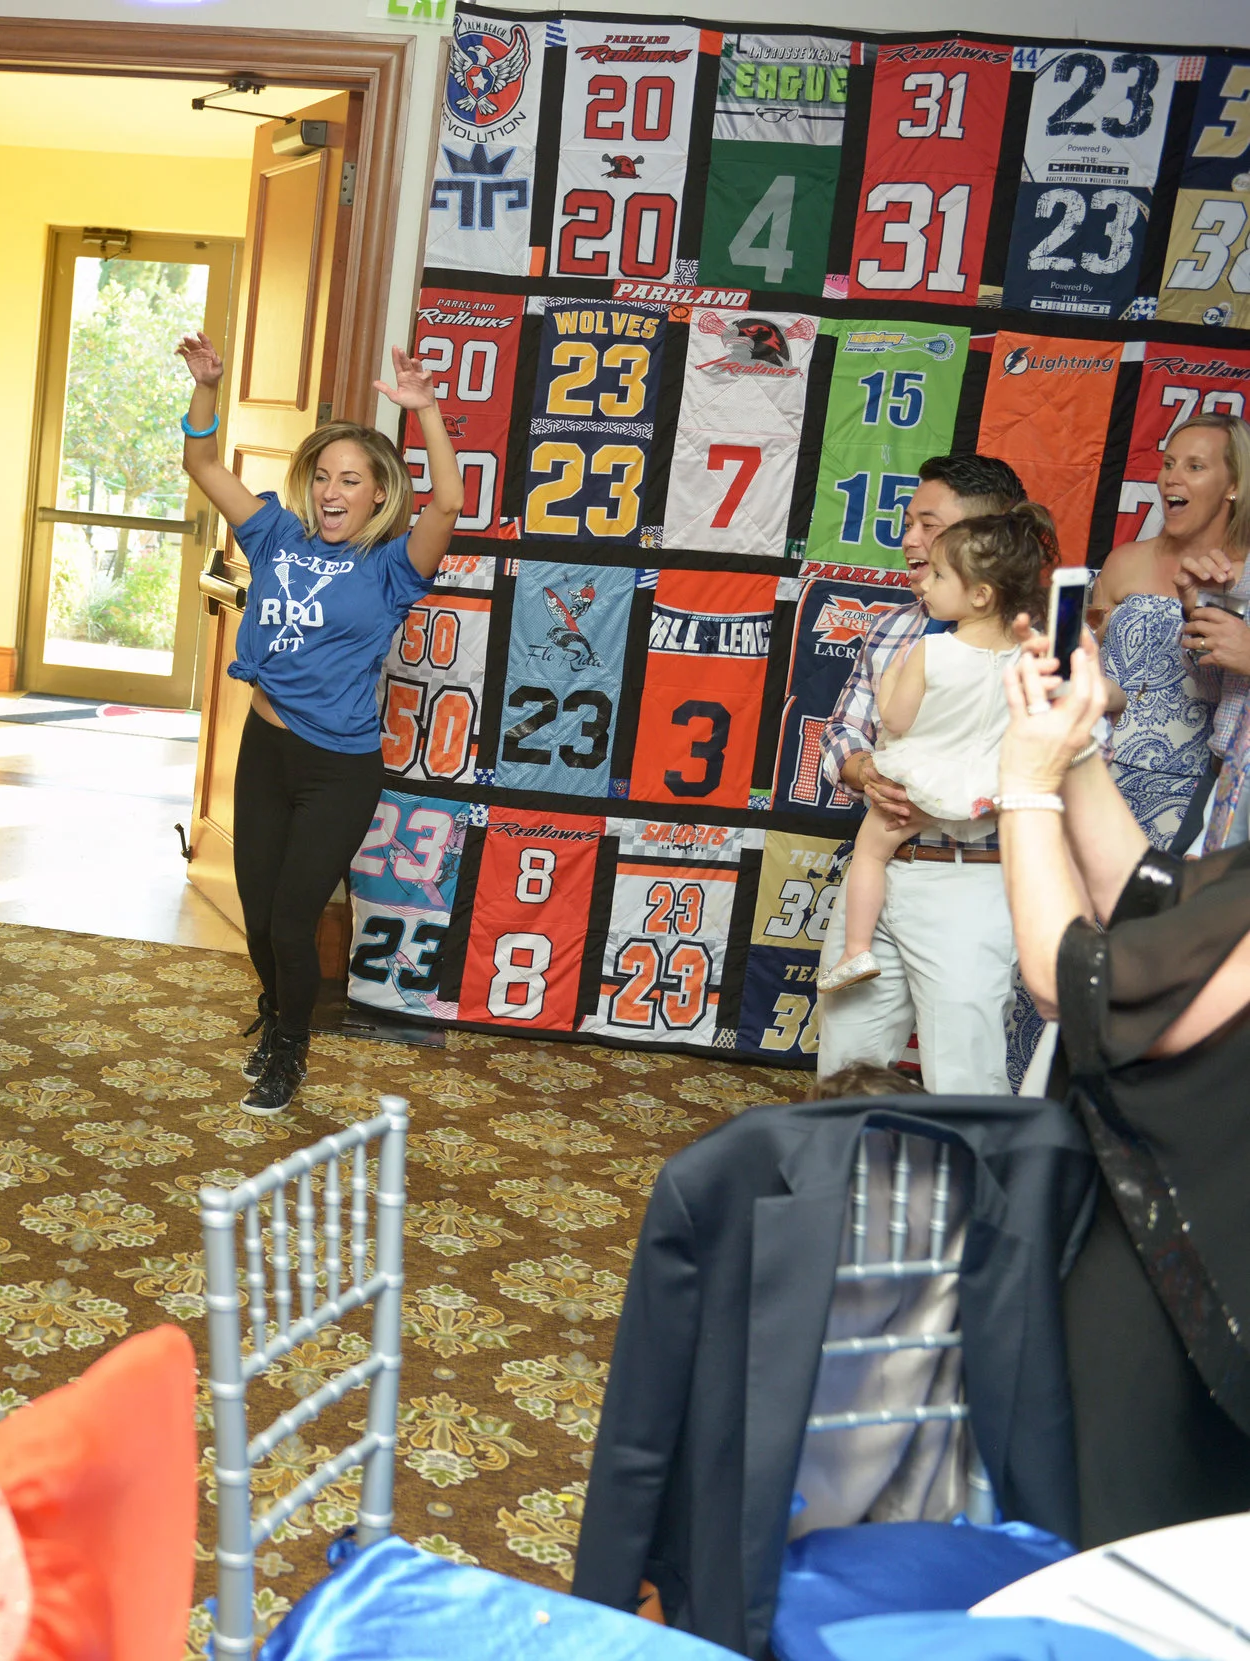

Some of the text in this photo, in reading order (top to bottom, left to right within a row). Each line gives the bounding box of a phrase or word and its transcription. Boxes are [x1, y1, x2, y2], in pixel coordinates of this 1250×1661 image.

[483, 22, 508, 38] BEACH
[575, 44, 694, 65] REDHAWKS
[604, 34, 671, 45] PARKLAND
[749, 45, 840, 62] LACROSSEWEAR
[877, 39, 1012, 65] REDHAWKS
[1012, 48, 1038, 69] 44
[584, 74, 675, 141] 20
[897, 71, 969, 140] 31
[1045, 53, 1159, 138] 23
[1048, 163, 1129, 176] CHAMBER
[1067, 144, 1112, 155] Powered By
[1081, 156, 1099, 164] THE
[557, 188, 678, 280] 20
[727, 175, 796, 284] 4
[856, 182, 972, 293] 31
[1027, 188, 1138, 275] 23
[436, 298, 496, 312] PARKLAND
[614, 282, 750, 308] PARKLAND
[1030, 299, 1111, 314] CHAMBER
[1050, 281, 1094, 293] Powered By
[417, 308, 515, 329] REDHAWKS
[552, 310, 660, 340] WOLVES
[417, 335, 500, 402] 20
[546, 341, 652, 418] 23
[715, 361, 800, 378] REDHAWKS
[1029, 354, 1115, 373] Lightning
[858, 369, 926, 430] 15
[524, 441, 647, 538] 23
[706, 444, 762, 529] 7
[834, 471, 920, 550] 15
[272, 548, 355, 576] DECKED
[258, 598, 324, 628] RPD
[398, 606, 461, 671] 50
[525, 644, 602, 673] Flo Rida
[382, 675, 480, 783] 50
[501, 685, 614, 769] 23
[663, 700, 732, 798] 3
[350, 801, 453, 883] 23
[488, 820, 601, 843] REDHAWKS
[514, 847, 557, 905] 8
[789, 849, 846, 872] TEAM
[642, 881, 705, 937] 23
[350, 915, 449, 993] 23
[486, 931, 553, 1020] 8
[607, 937, 715, 1032] 23
